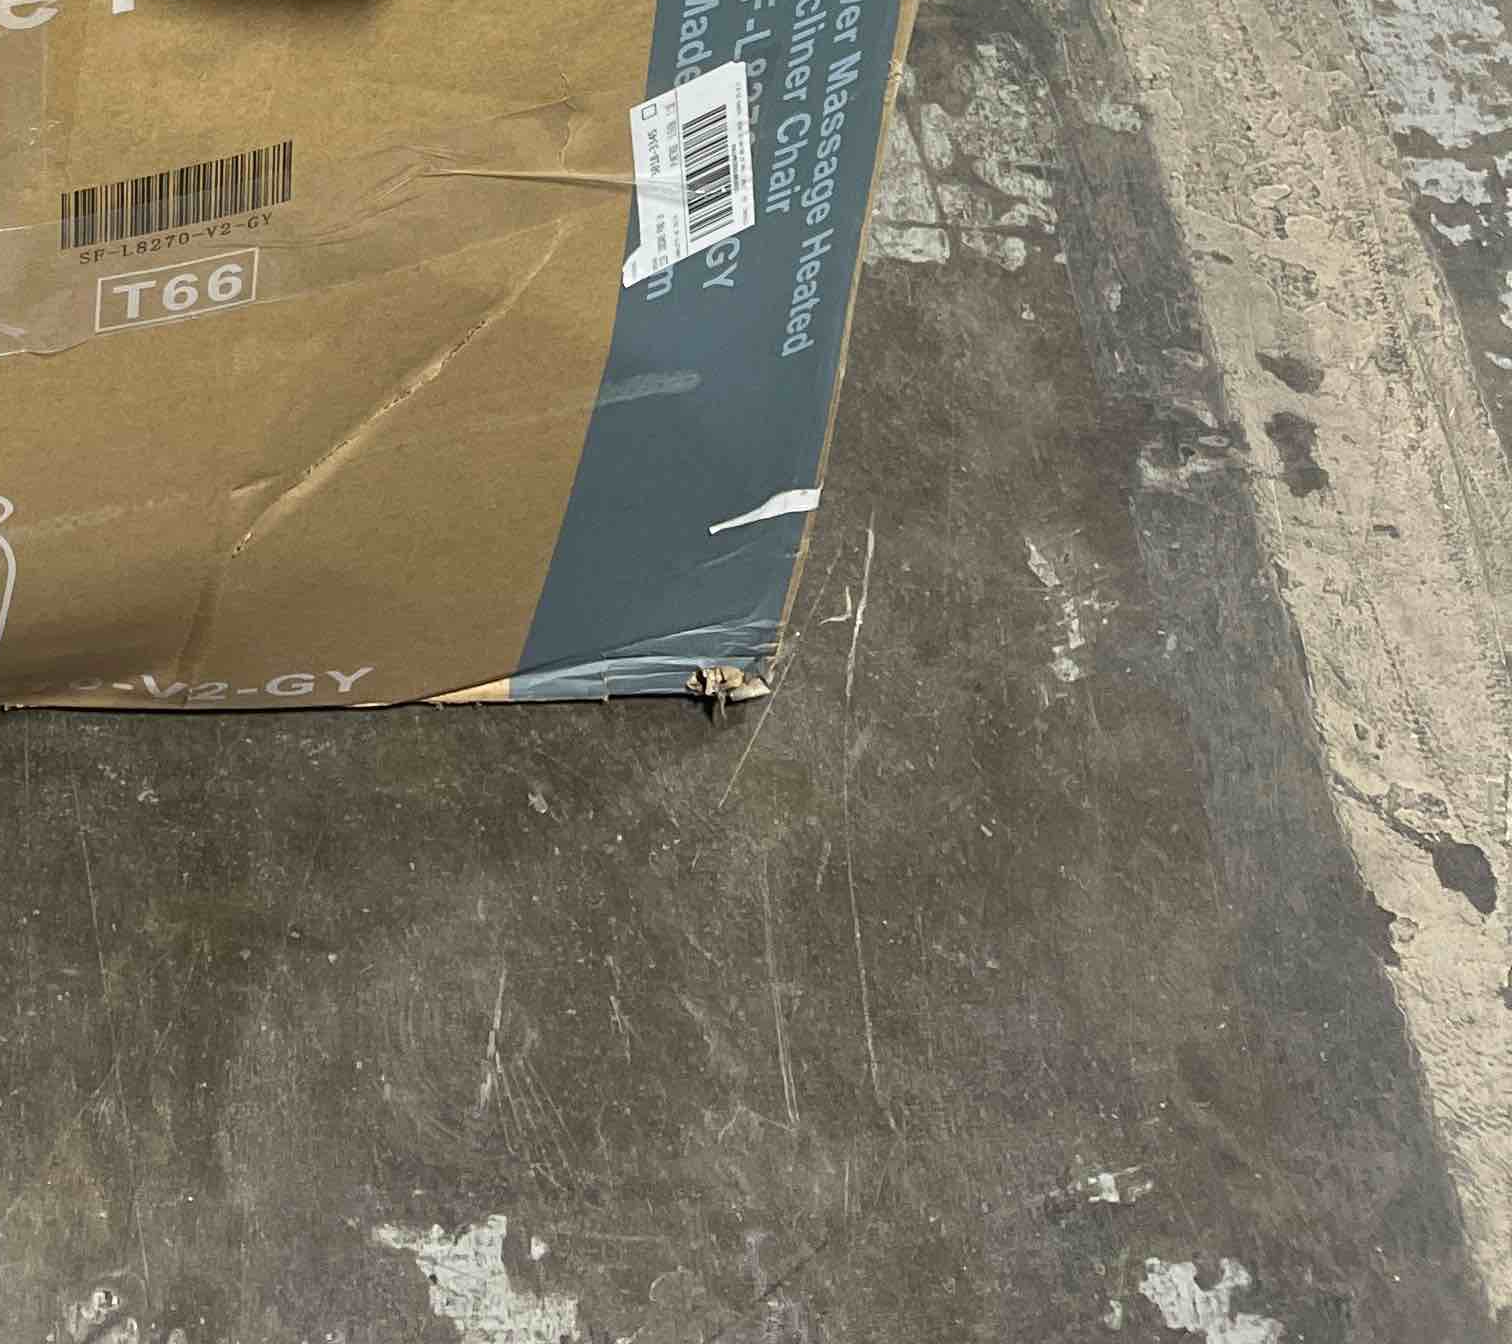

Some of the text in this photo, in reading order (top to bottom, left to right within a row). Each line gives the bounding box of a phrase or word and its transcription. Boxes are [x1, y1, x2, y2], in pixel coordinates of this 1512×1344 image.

[765, 112, 813, 216] Chair
[800, 49, 865, 226] Massage
[112, 263, 244, 320] T66
[780, 225, 834, 358] Heated
